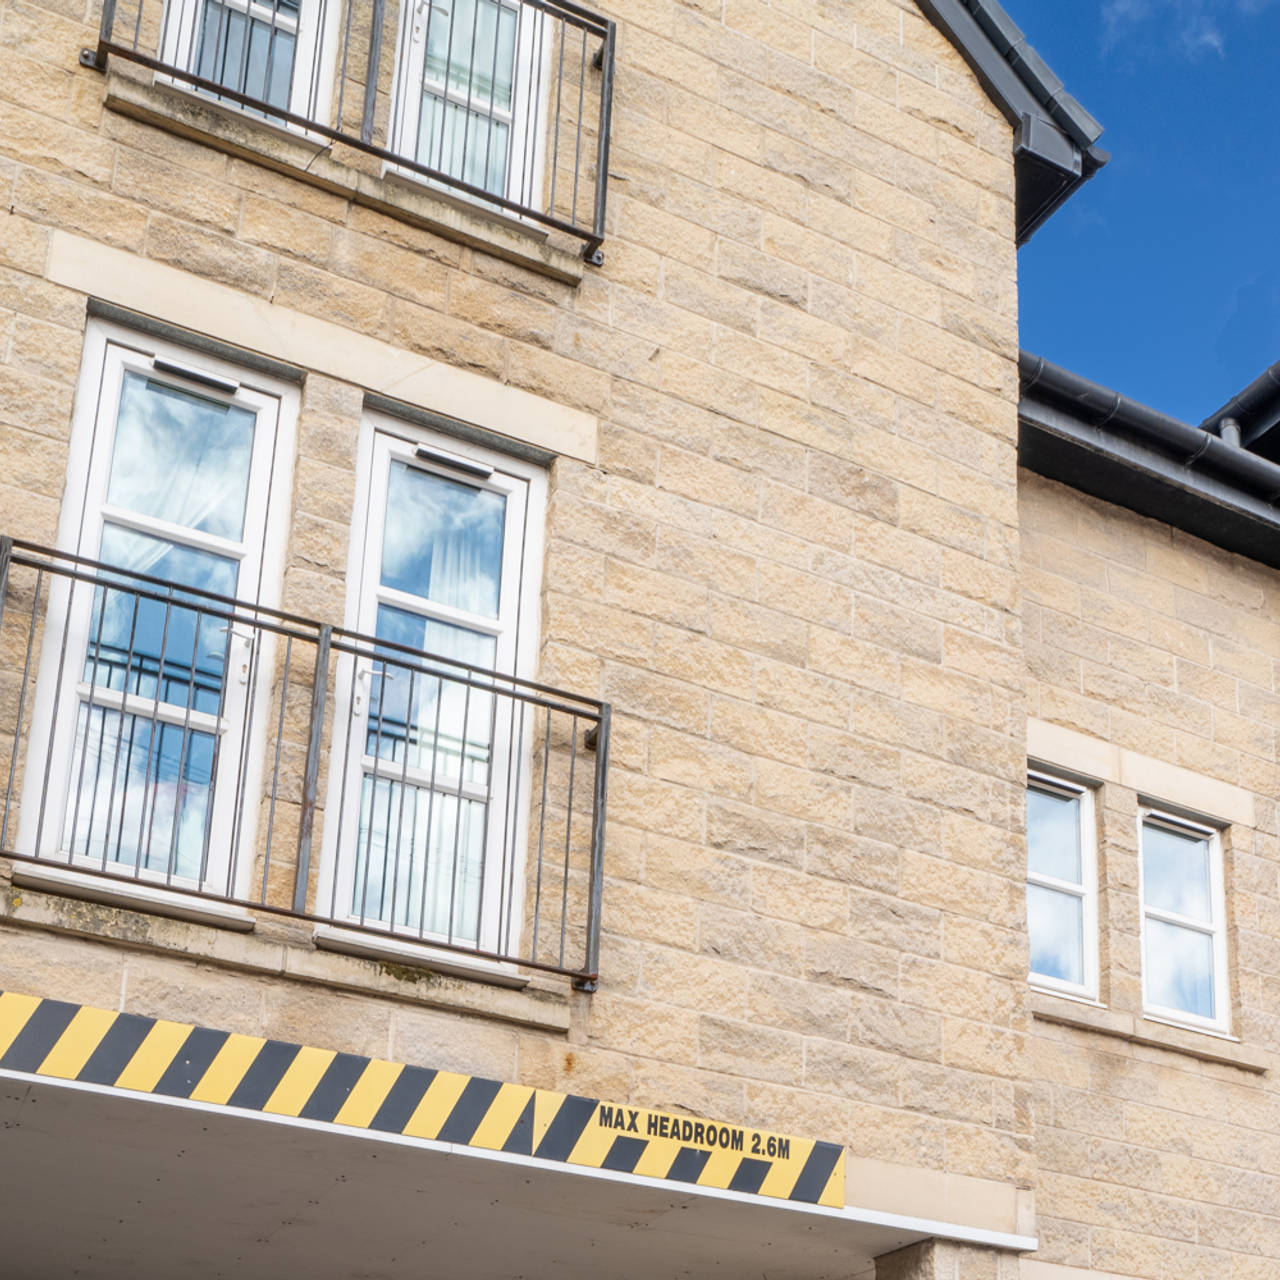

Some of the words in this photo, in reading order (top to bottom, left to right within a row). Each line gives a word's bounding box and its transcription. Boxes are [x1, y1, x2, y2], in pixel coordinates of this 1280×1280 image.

[599, 1106, 639, 1132] MAX
[647, 1114, 744, 1151] HEADROOM
[751, 1133, 790, 1160] 2.6M
